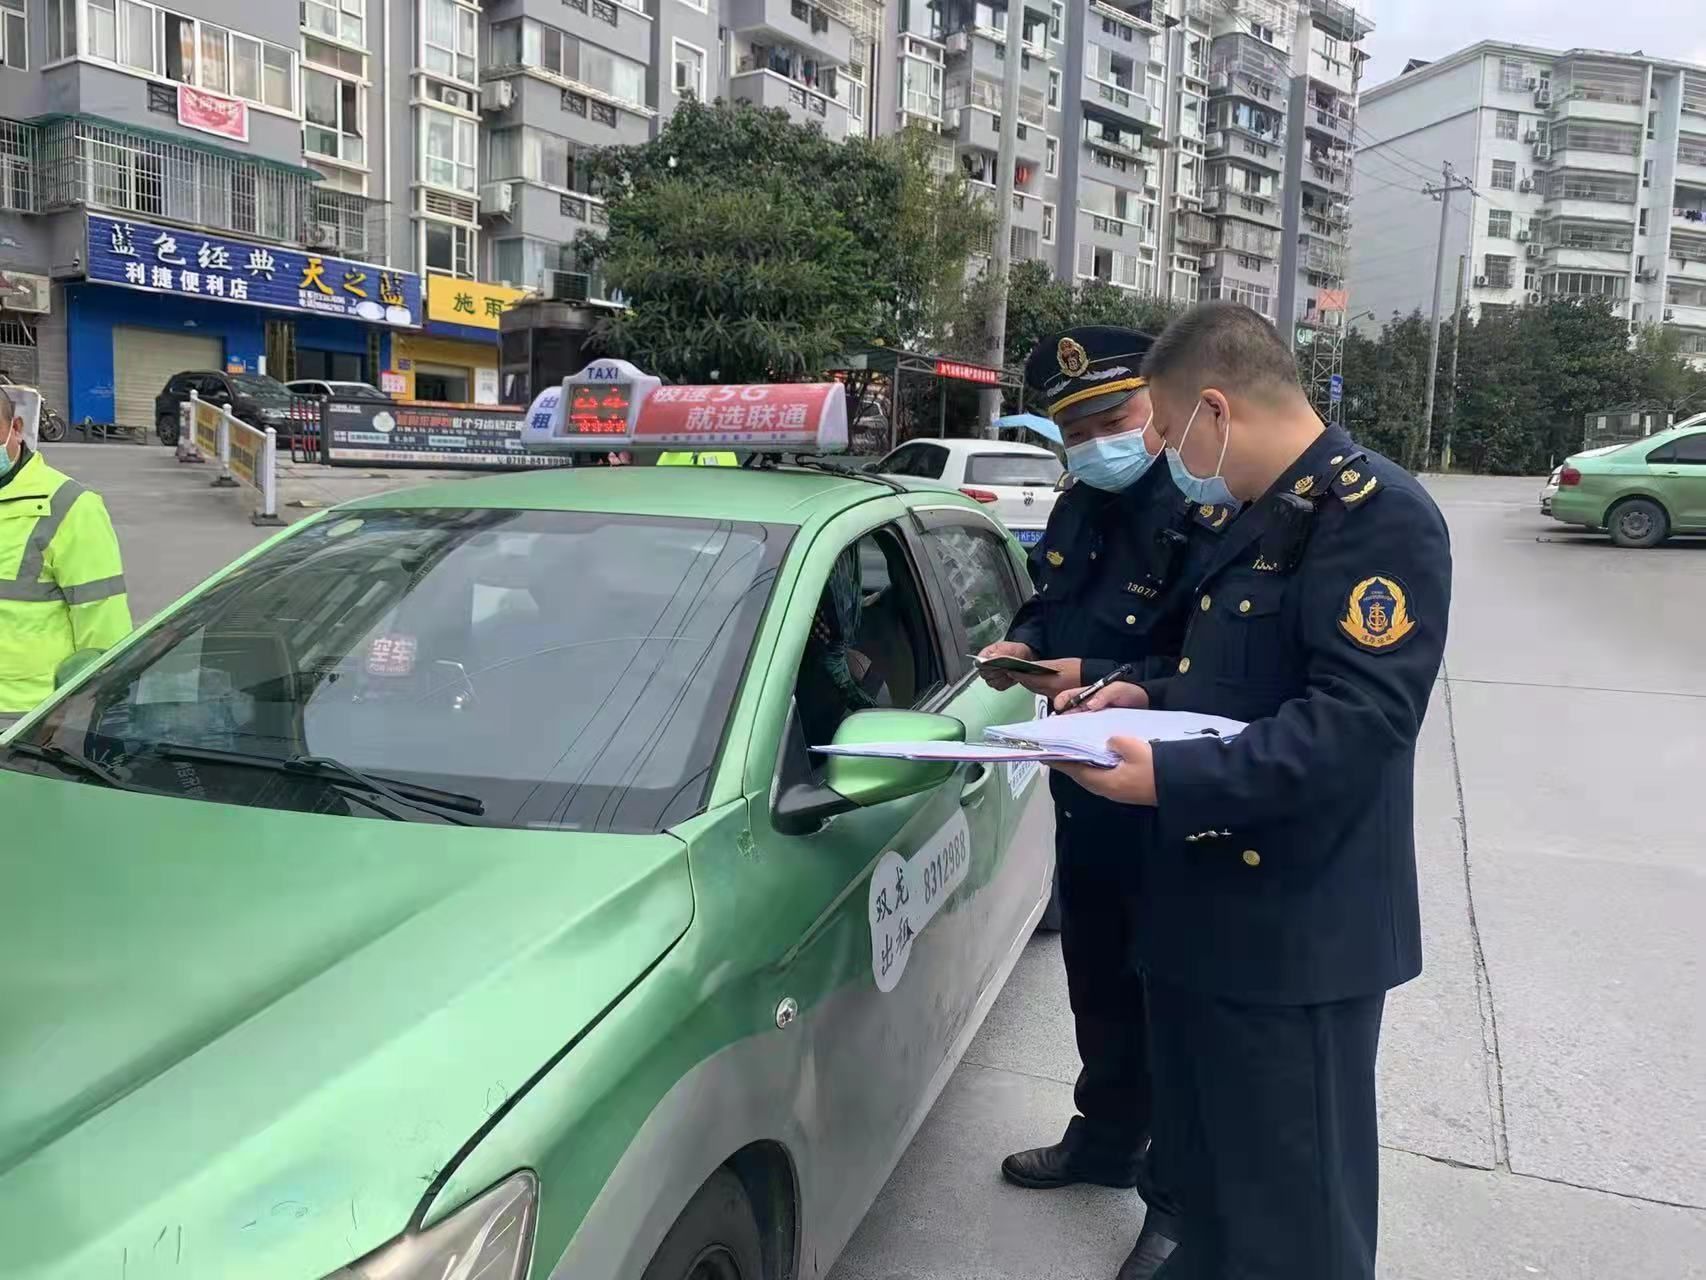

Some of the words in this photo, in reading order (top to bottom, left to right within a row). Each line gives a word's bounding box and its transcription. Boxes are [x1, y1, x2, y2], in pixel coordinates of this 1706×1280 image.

[125, 262, 248, 300] 利捷便利店
[586, 366, 619, 379] TAXI
[531, 396, 559, 429] 出租
[685, 404, 809, 430] 就选联通
[923, 829, 967, 905] 8312988
[880, 915, 914, 977] 出租
